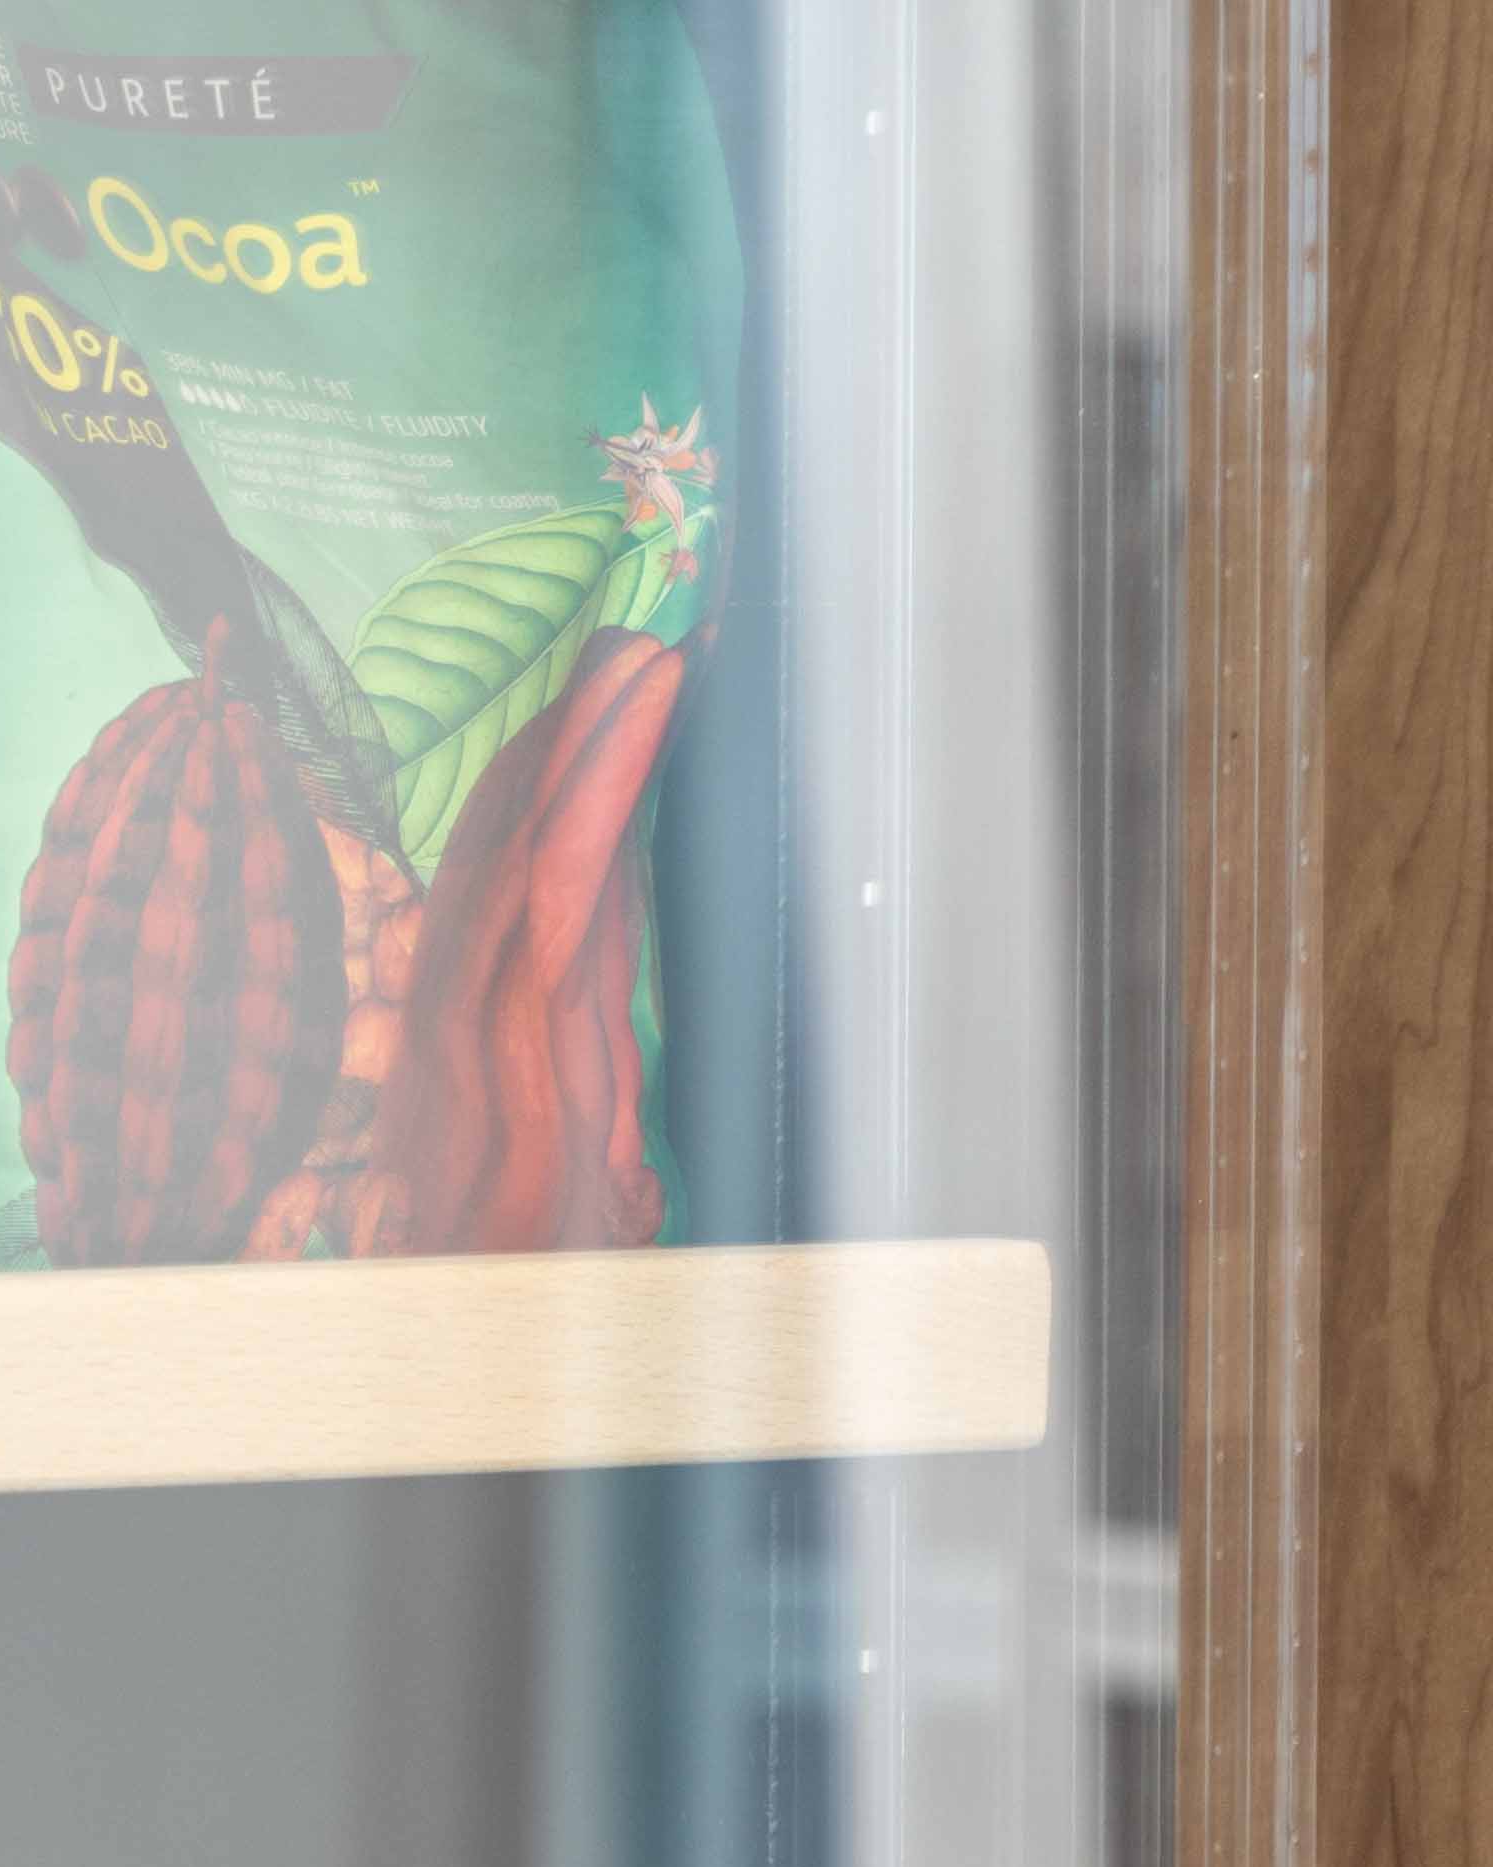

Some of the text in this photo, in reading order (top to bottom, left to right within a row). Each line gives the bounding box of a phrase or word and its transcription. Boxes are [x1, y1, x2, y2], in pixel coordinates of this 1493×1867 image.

[44, 66, 278, 122] PURETÉ
[61, 411, 168, 450] CACAO
[379, 413, 490, 438] FLUIDITY
